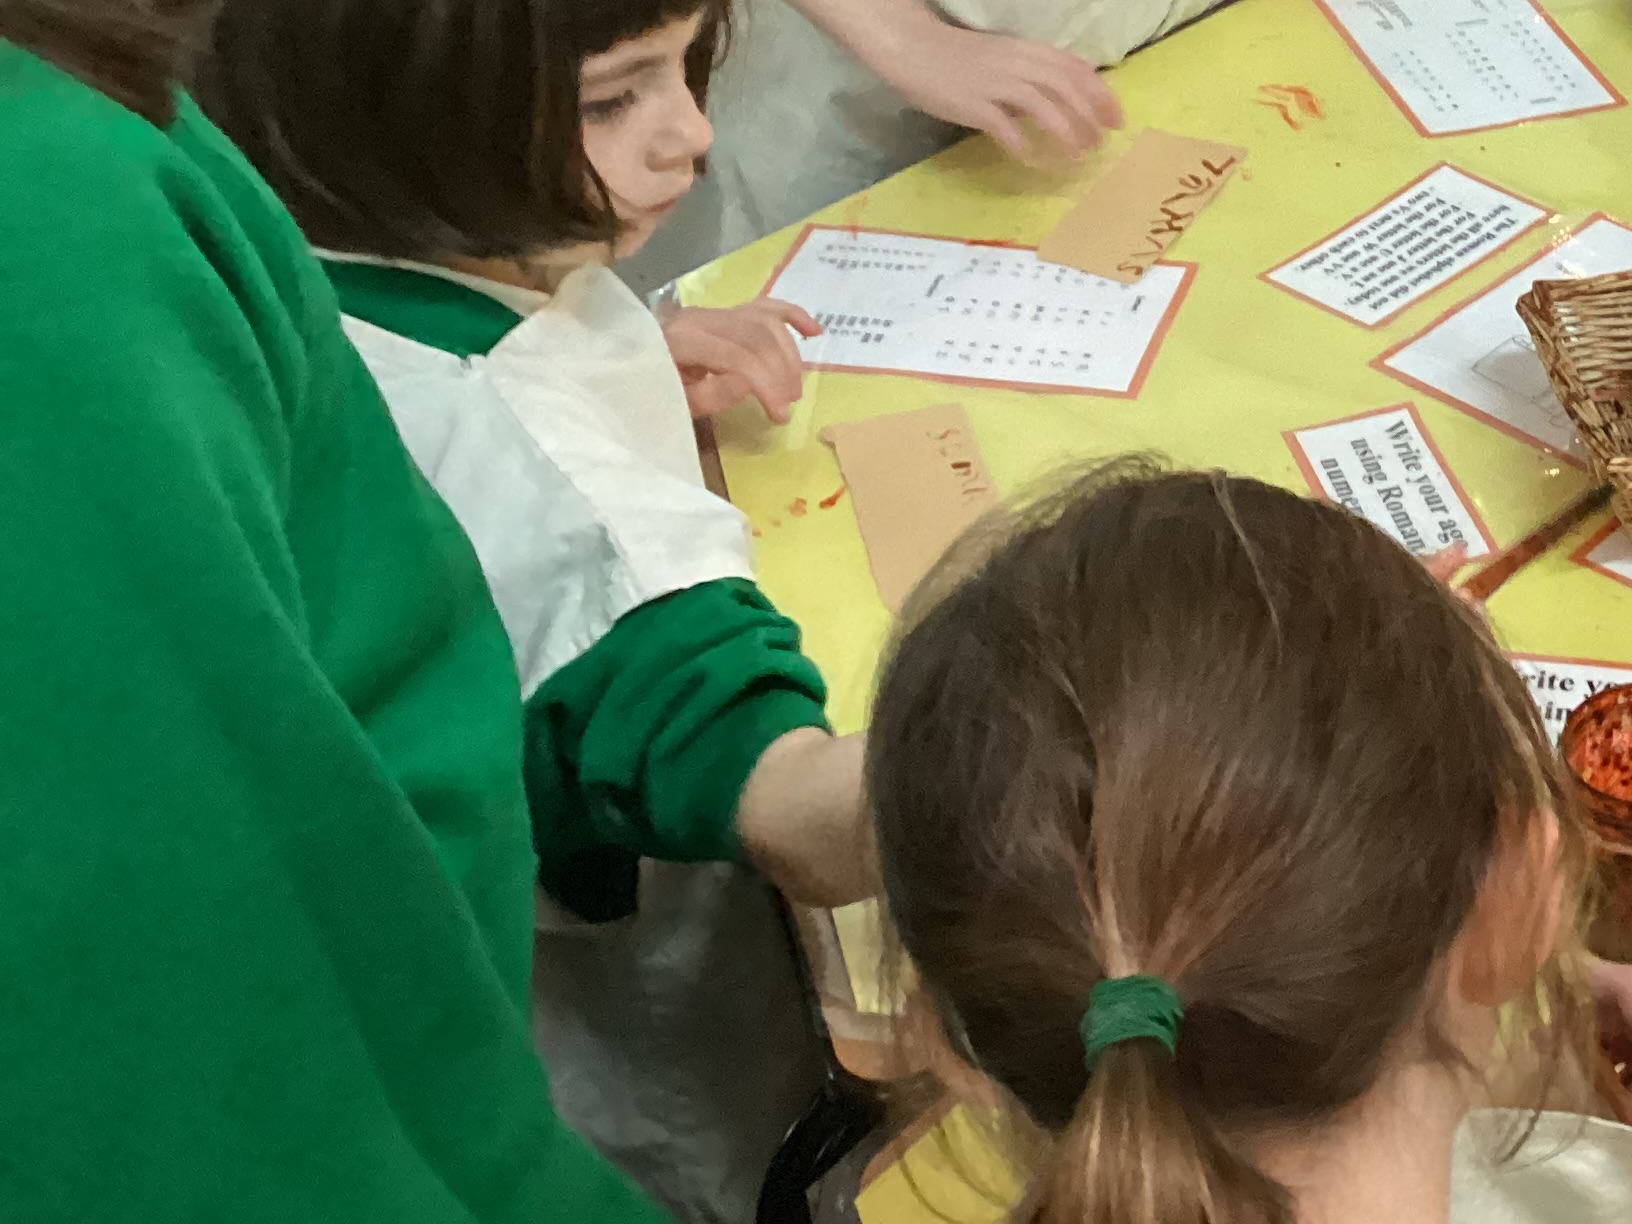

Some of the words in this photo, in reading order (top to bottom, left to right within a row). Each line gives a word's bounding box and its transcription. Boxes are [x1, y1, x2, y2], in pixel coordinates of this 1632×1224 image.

[1350, 437, 1388, 486] using
[1377, 484, 1427, 552] Roman
[1385, 419, 1422, 472] Write
[1404, 473, 1450, 515] your
[1522, 670, 1575, 692] rite
